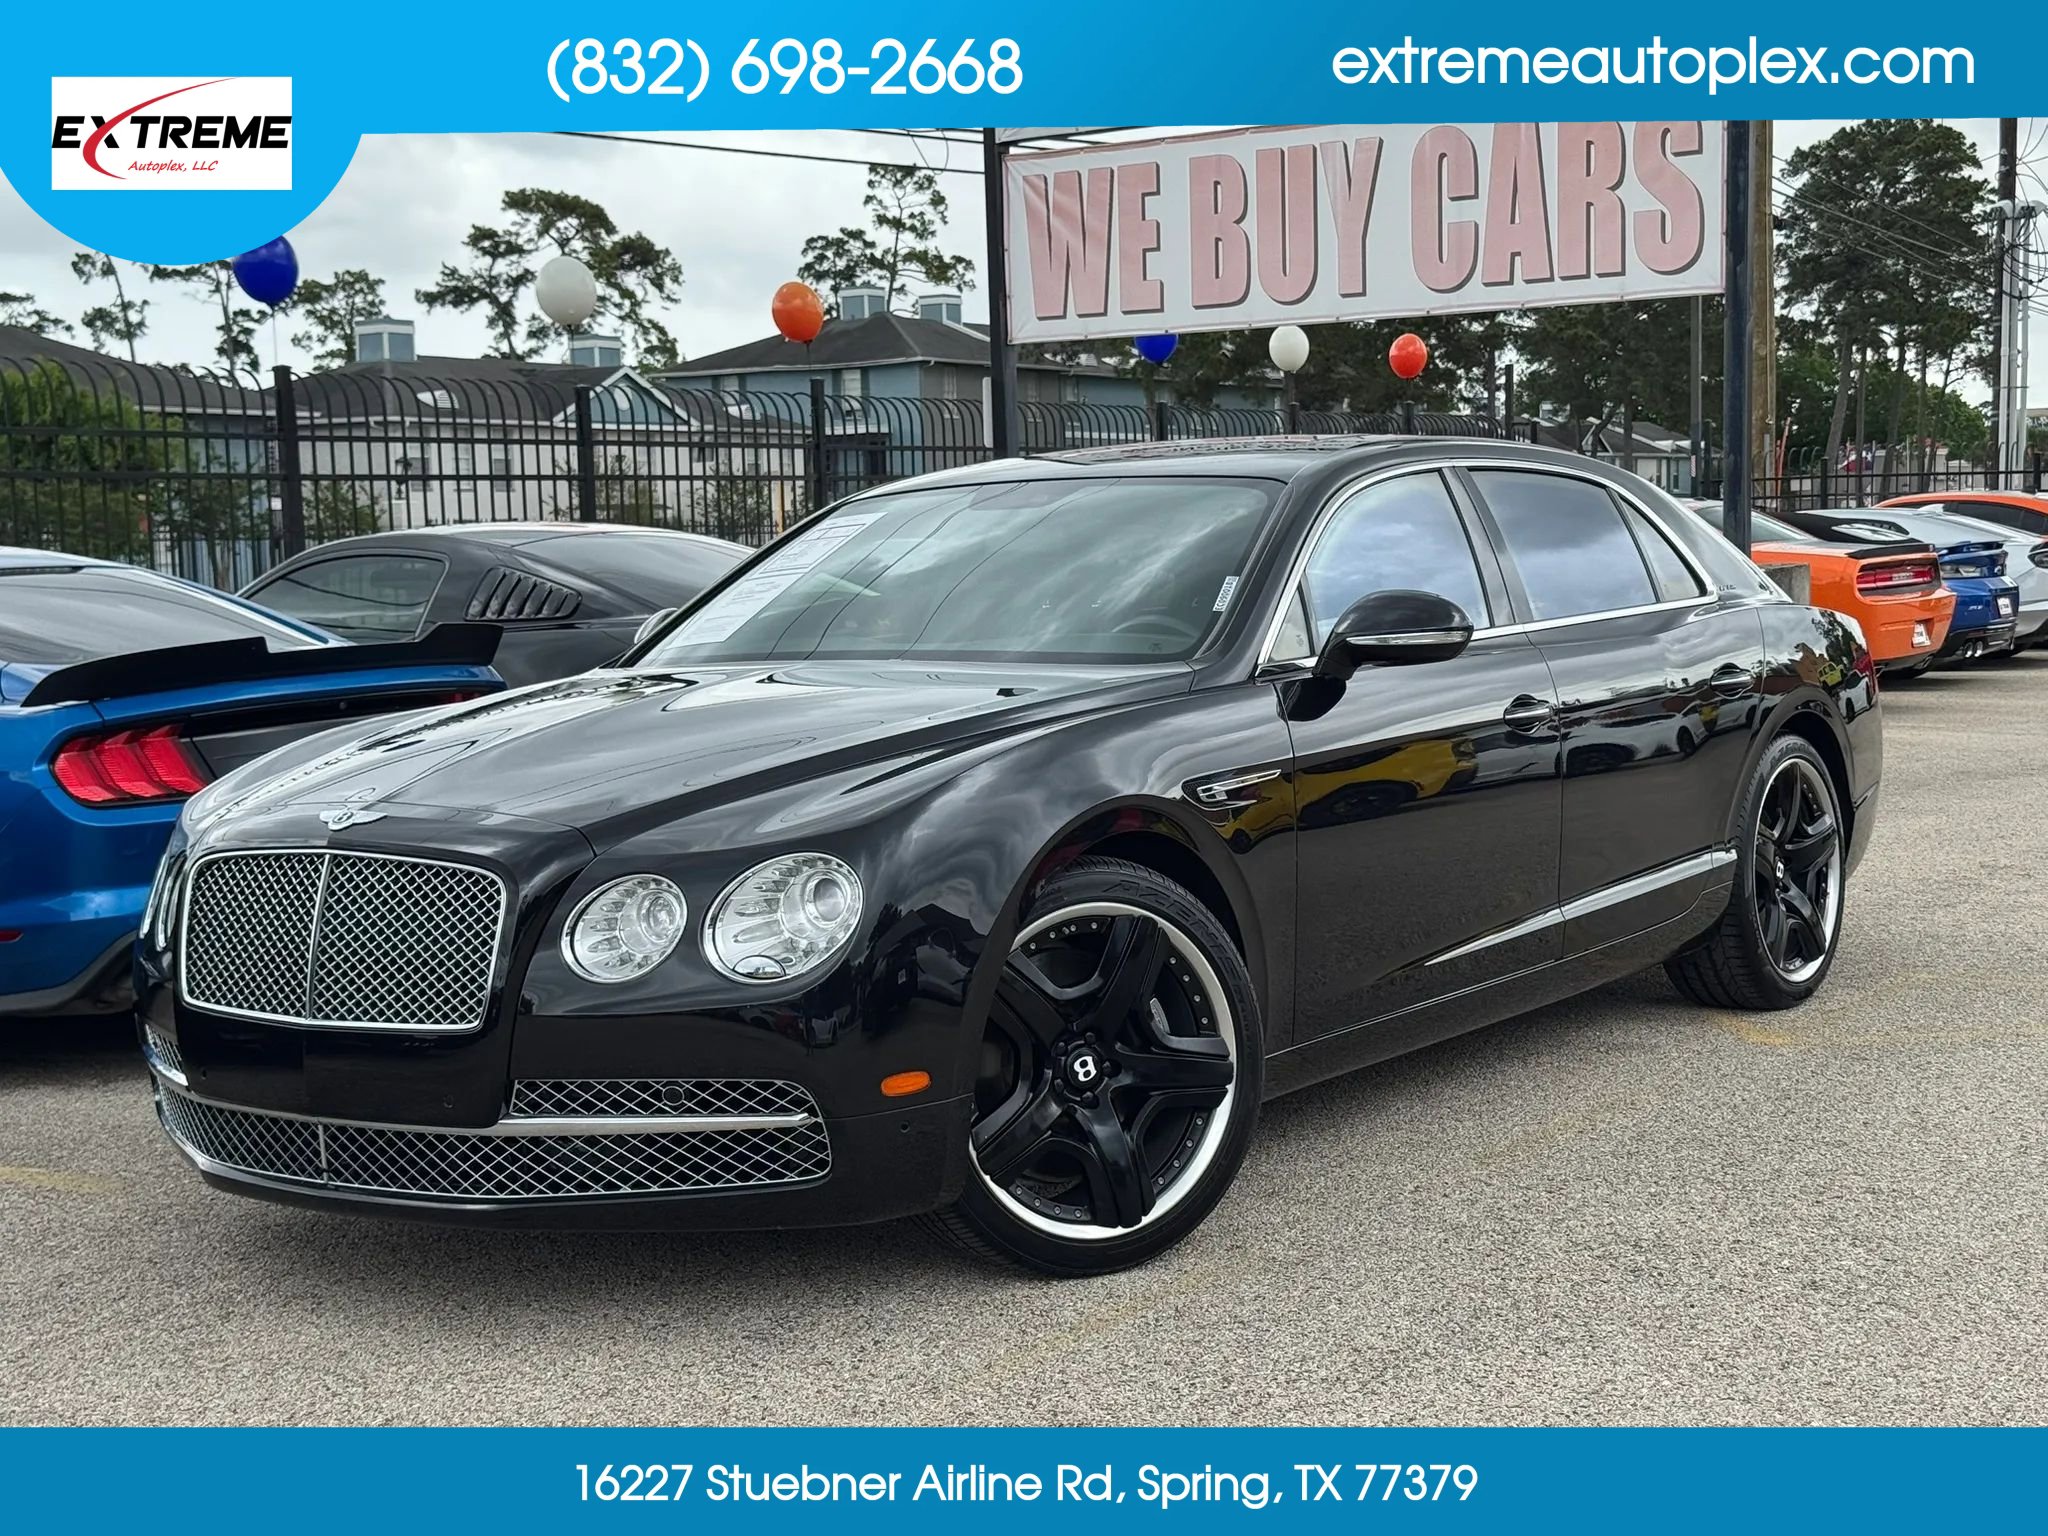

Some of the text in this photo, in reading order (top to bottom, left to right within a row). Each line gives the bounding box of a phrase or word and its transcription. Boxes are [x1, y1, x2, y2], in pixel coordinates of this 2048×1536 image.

[1022, 121, 1706, 320] WE BUY CARS
[1073, 1056, 1097, 1082] B
